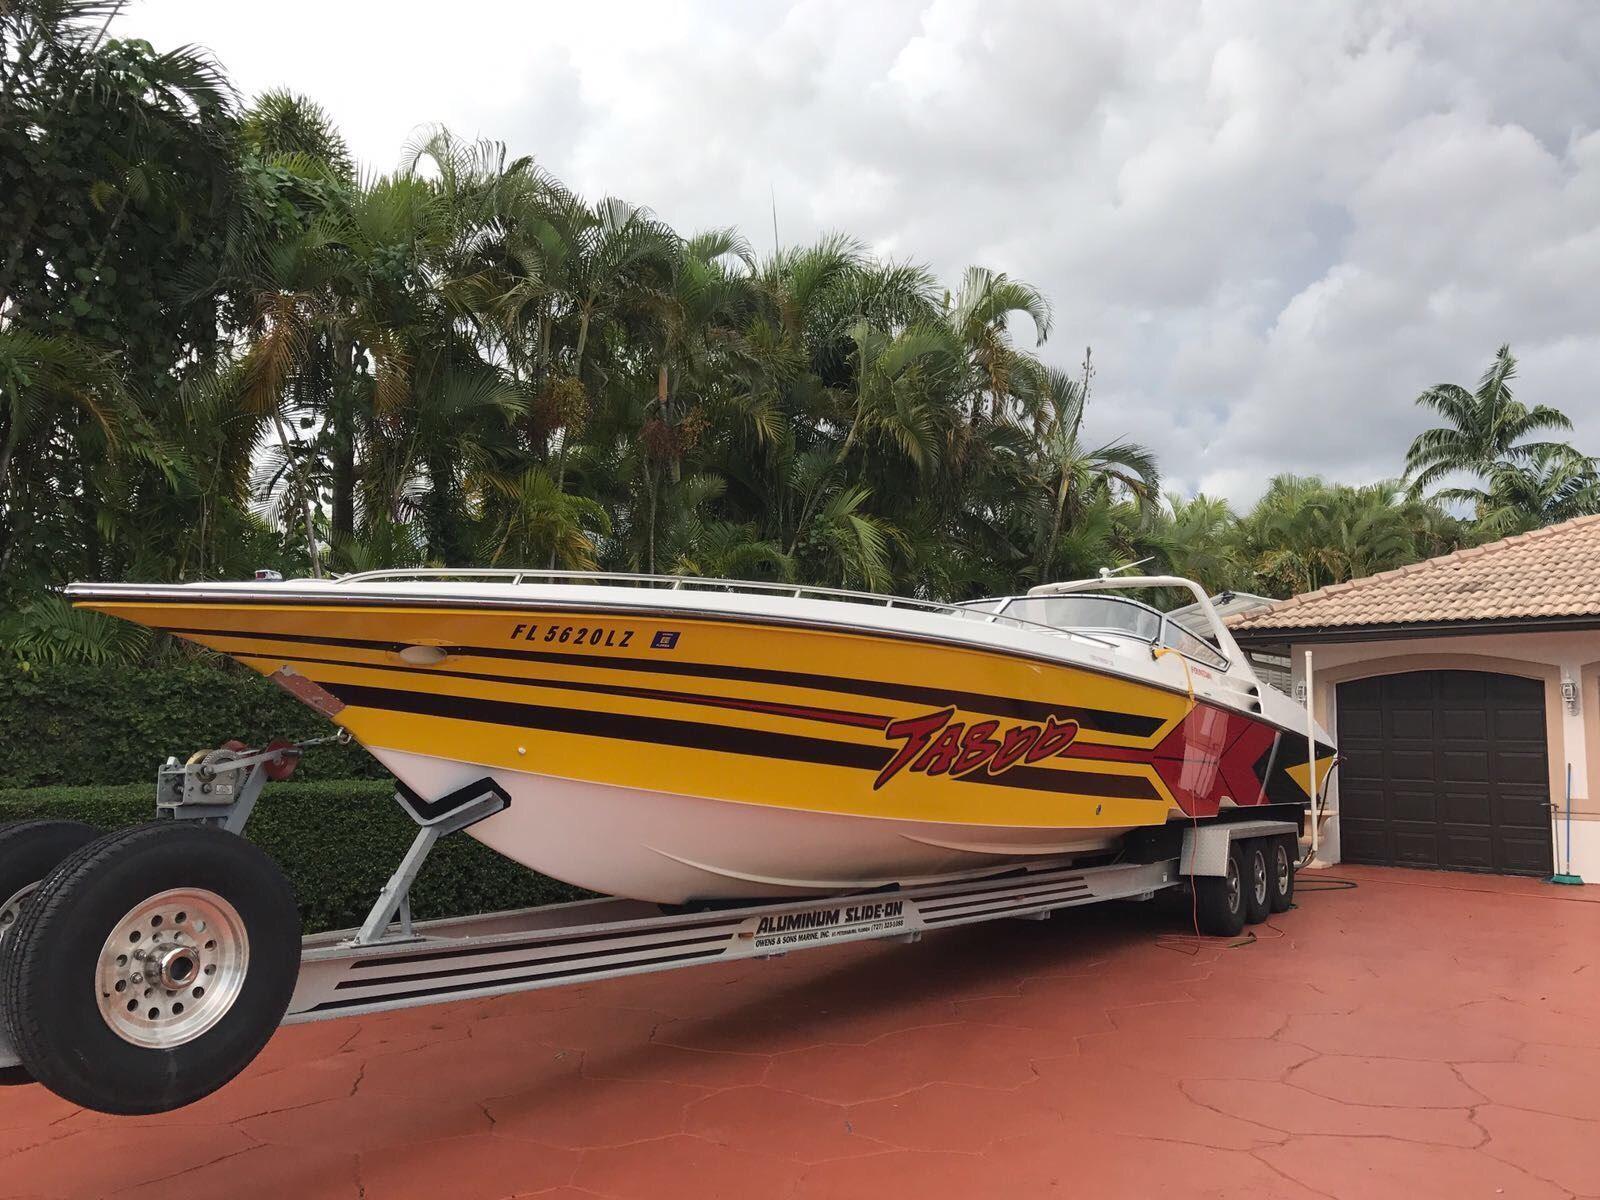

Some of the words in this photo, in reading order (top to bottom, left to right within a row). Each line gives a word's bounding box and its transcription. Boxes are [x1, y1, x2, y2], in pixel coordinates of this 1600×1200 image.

[510, 624, 537, 641] FL
[543, 626, 634, 647] 5620LZ
[873, 704, 1079, 791] TABOO
[756, 909, 840, 935] ALUMINUM
[845, 901, 904, 922] SLIDE-ON
[756, 938, 775, 948] OWENS
[776, 937, 781, 945] &
[782, 935, 797, 944] SONS
